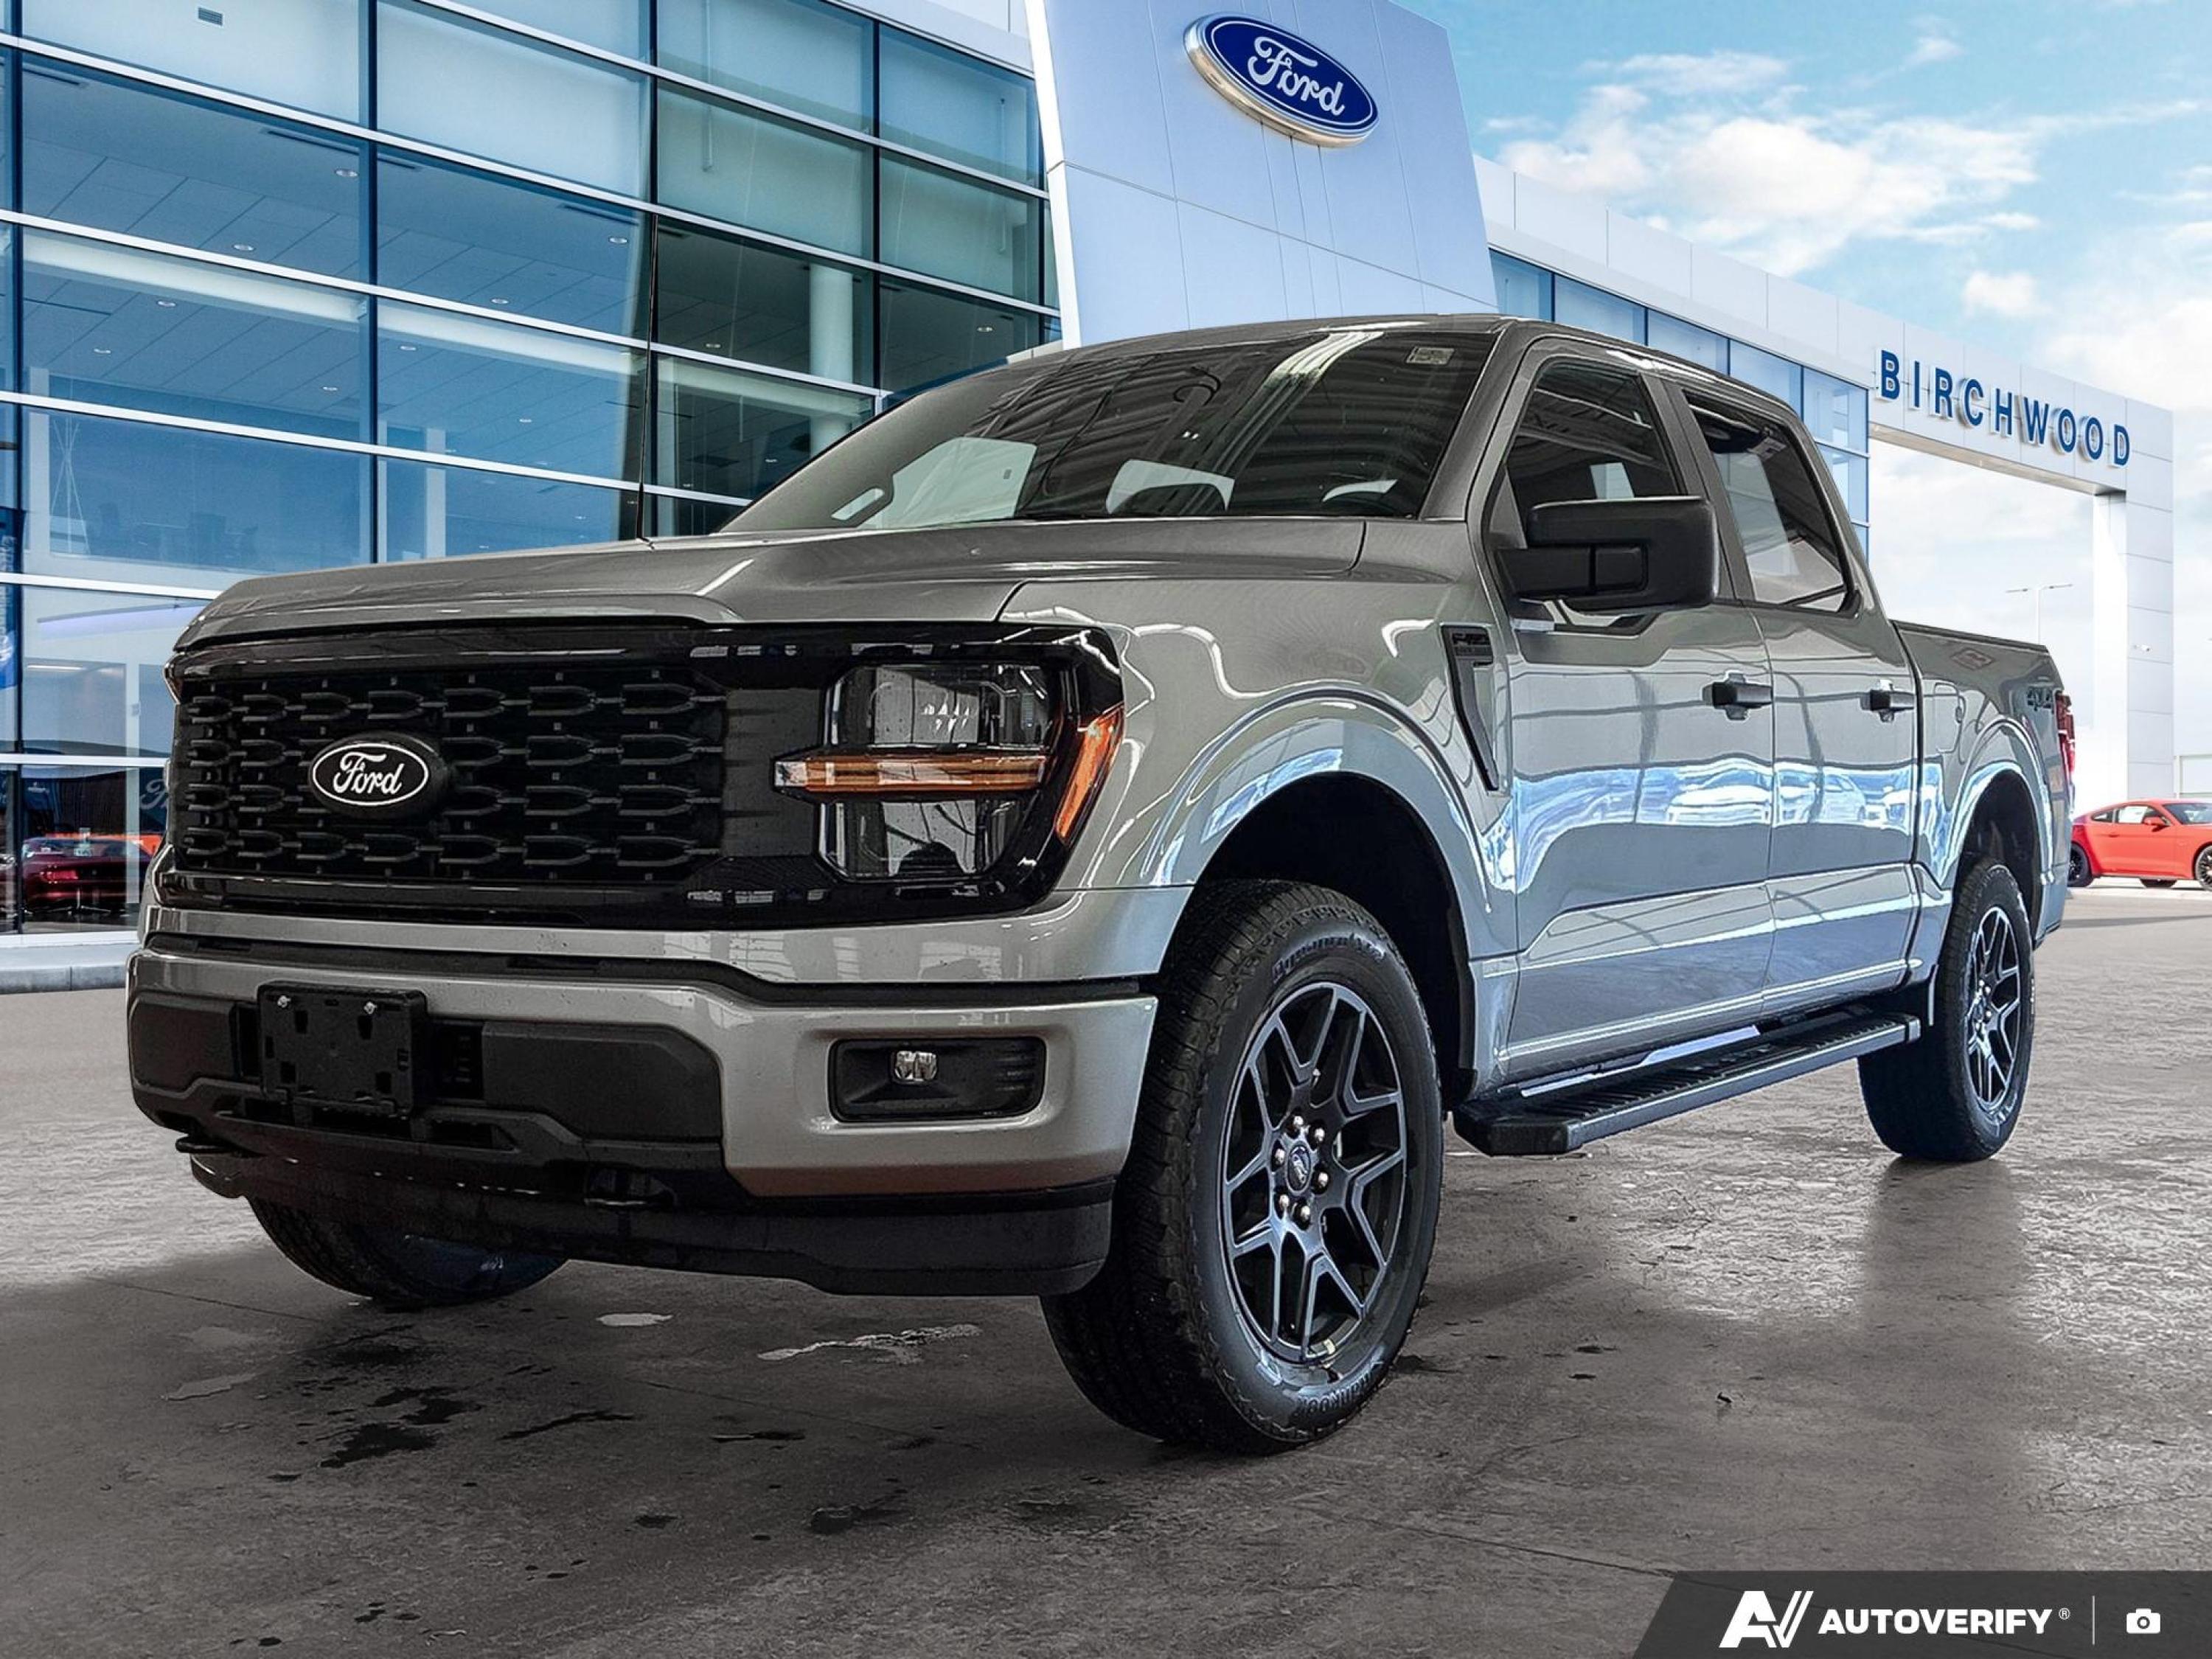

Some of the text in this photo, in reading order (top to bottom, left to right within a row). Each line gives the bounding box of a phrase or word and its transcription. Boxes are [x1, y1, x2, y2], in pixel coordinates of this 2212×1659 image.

[1247, 36, 1346, 116] Ford
[1879, 349, 2131, 467] BIRCHWOOD
[333, 751, 405, 795] Ford
